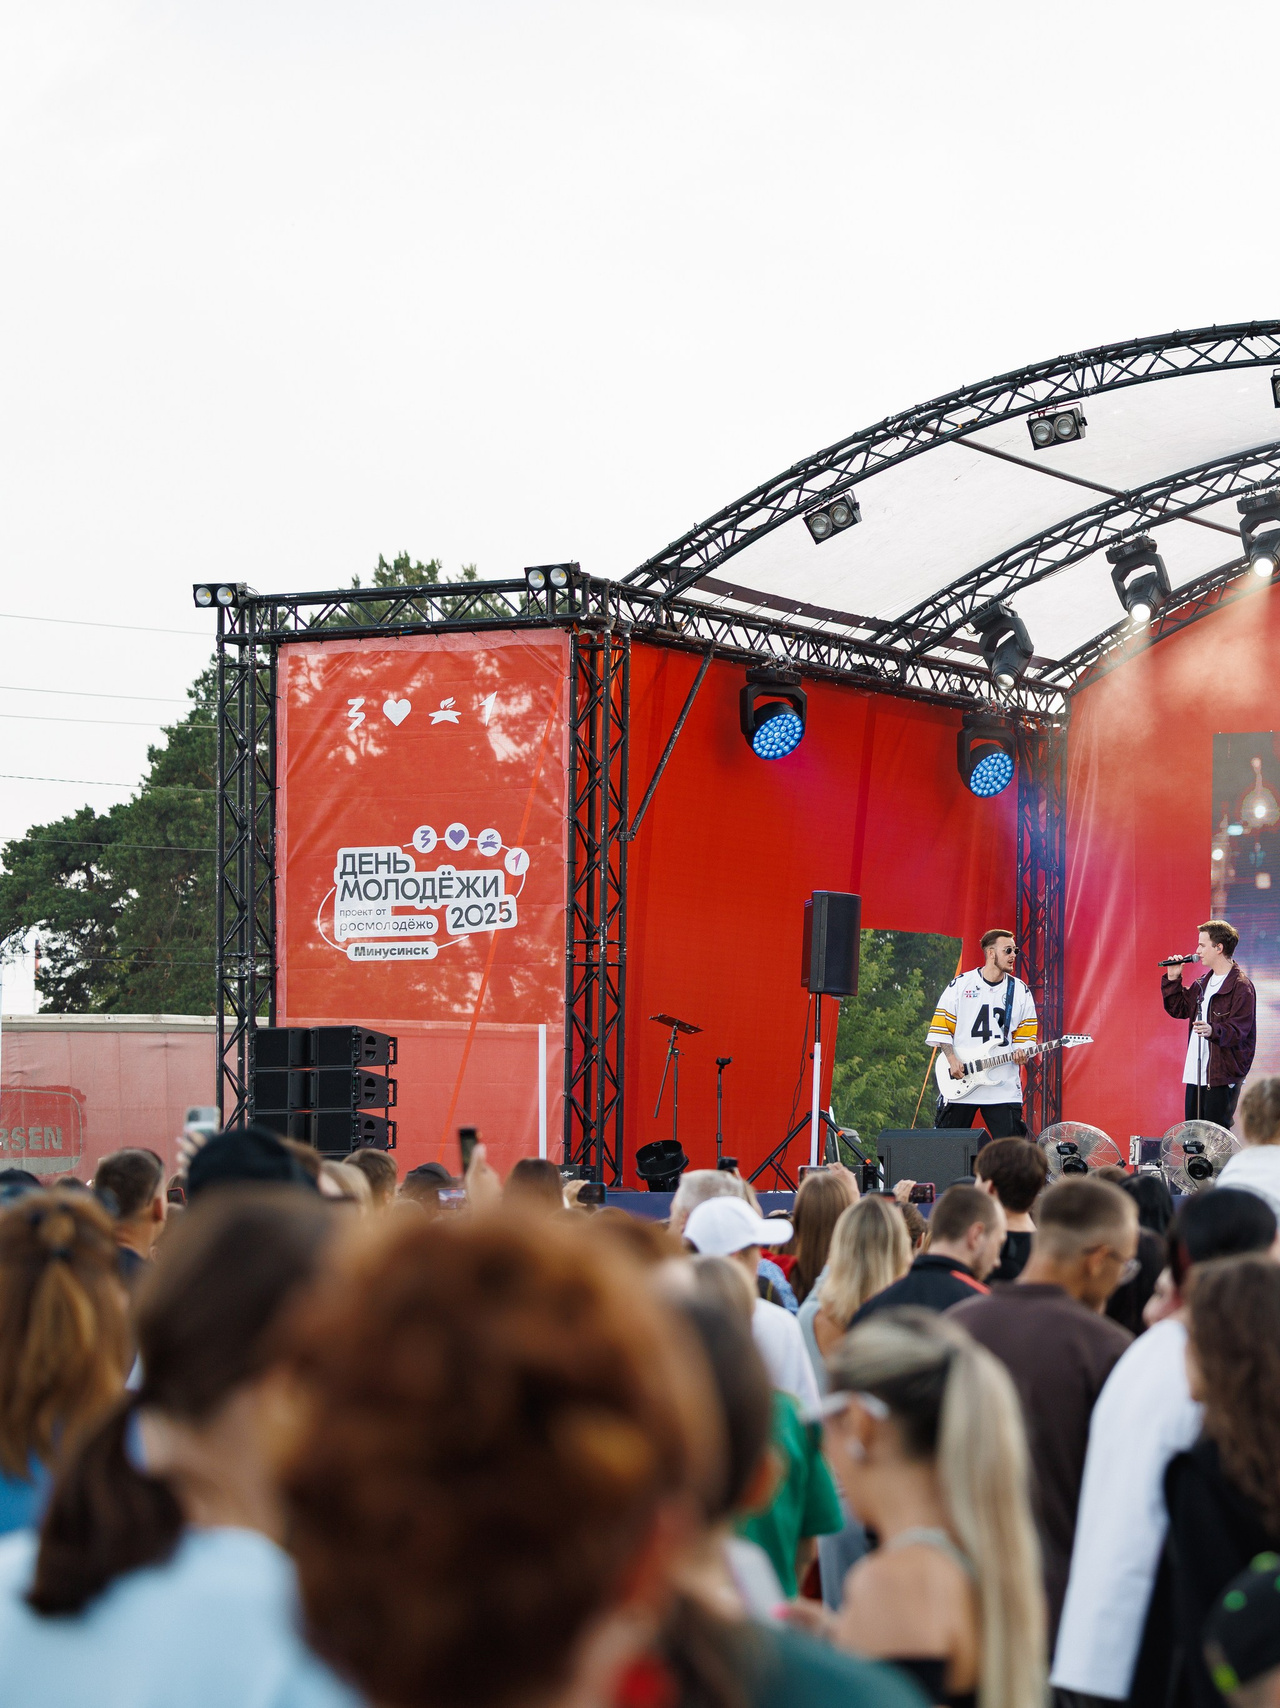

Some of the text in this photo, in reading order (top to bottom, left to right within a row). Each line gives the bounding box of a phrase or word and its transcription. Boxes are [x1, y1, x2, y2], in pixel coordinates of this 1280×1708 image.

[339, 852, 411, 879] ДЕНЬ
[340, 871, 499, 903] МОЛОДЁЖИ
[339, 908, 387, 917] проект от
[451, 901, 513, 929] 2025
[339, 919, 434, 936] росмолодёжь
[353, 946, 429, 959] Минусинск
